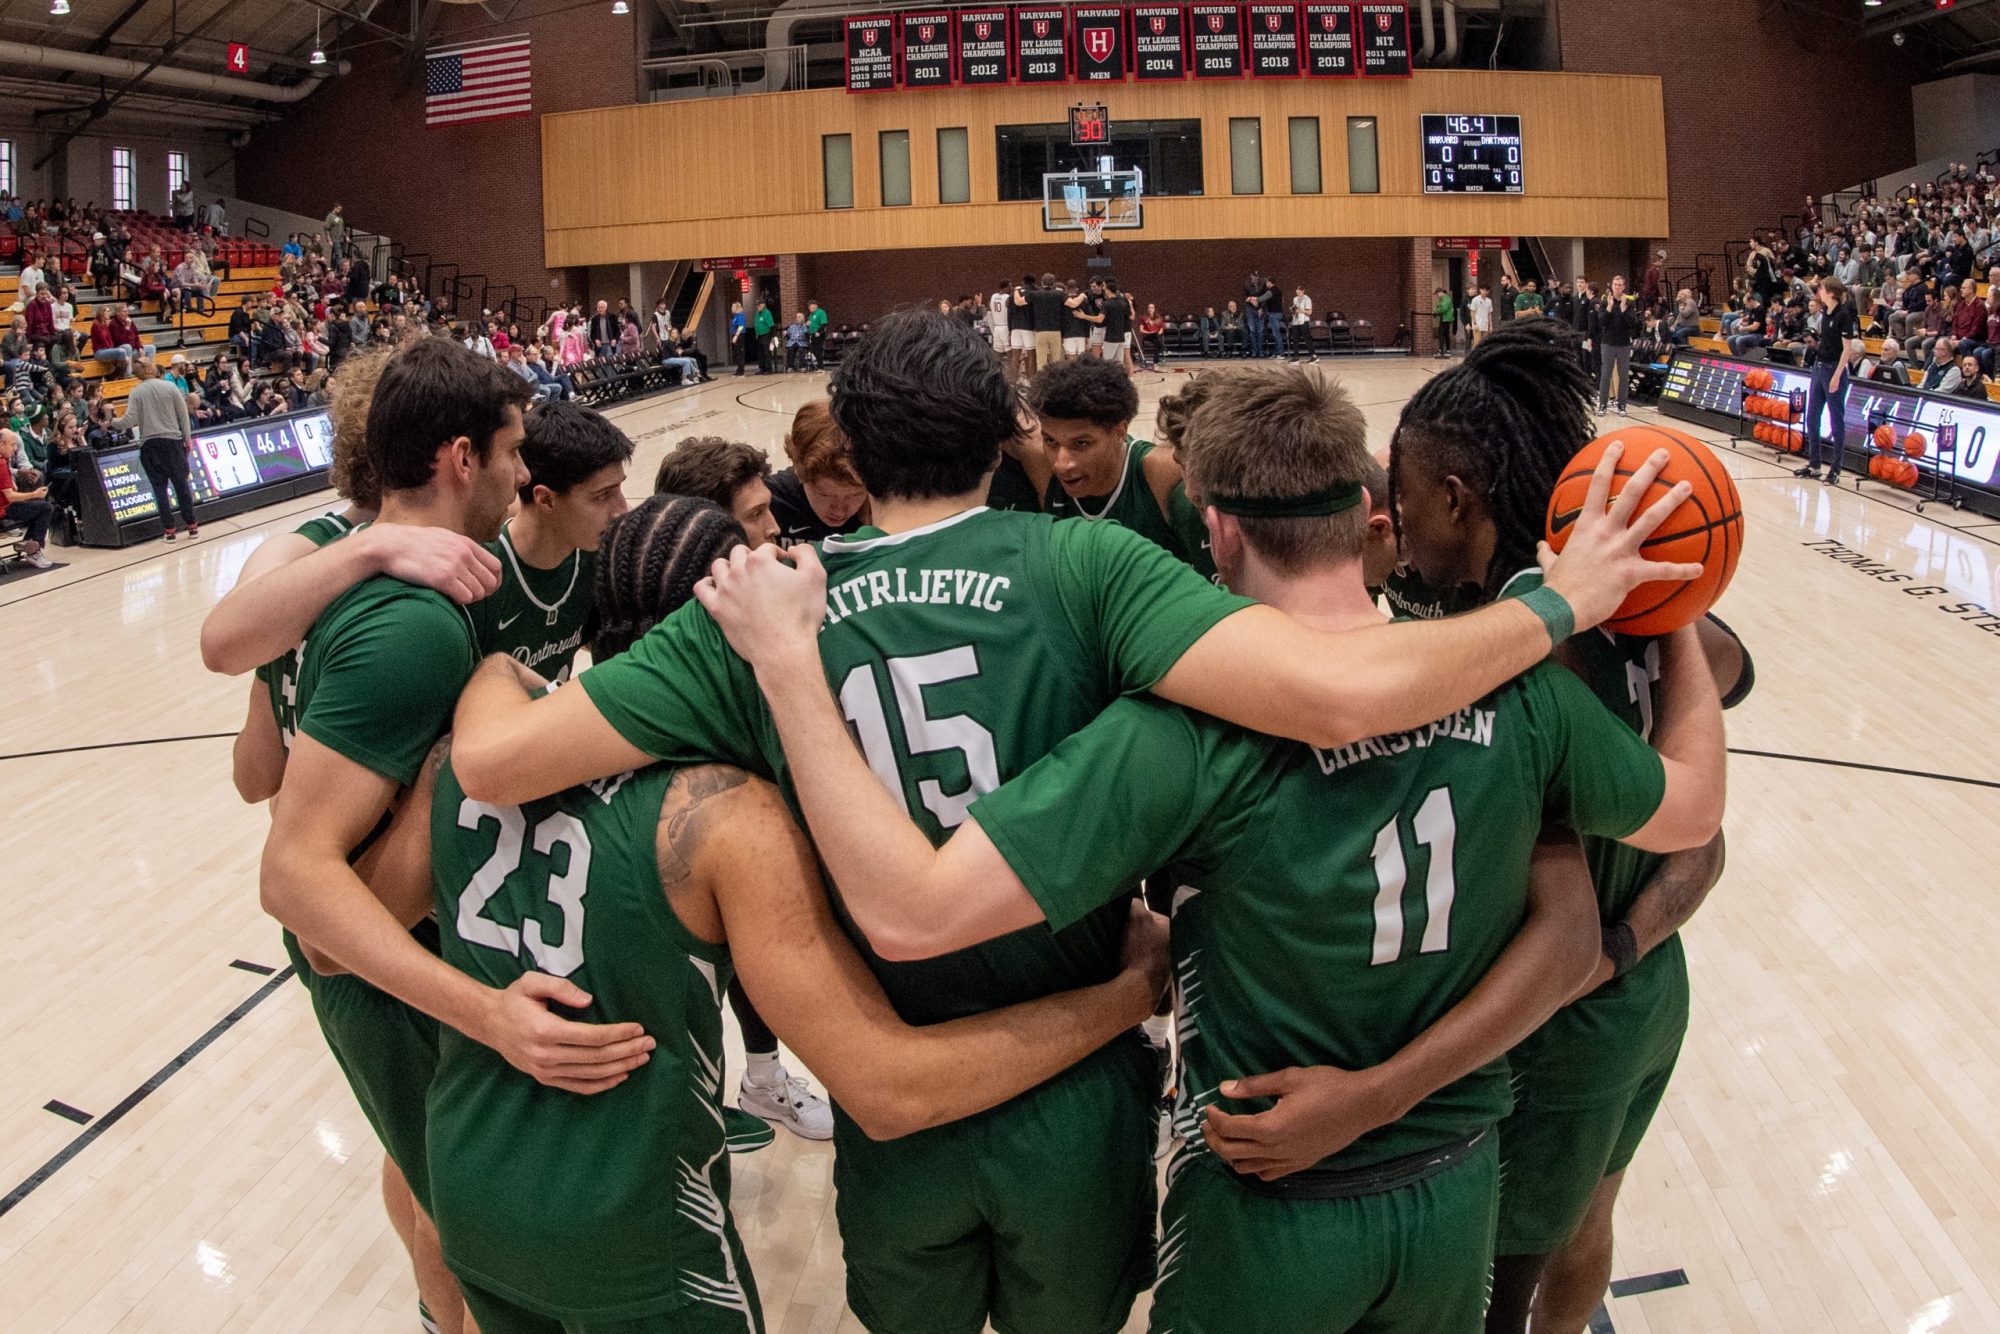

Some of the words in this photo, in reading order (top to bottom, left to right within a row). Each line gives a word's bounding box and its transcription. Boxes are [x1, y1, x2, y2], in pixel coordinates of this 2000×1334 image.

[1077, 9, 1120, 18] HARVARD
[1136, 8, 1179, 16] HARVARD
[1194, 6, 1236, 14] HARVARD
[1252, 5, 1294, 13] HARVARD
[1308, 5, 1349, 13] HARVARD
[1363, 5, 1404, 13] HARVARD
[906, 15, 947, 25] HARVARD
[962, 12, 1004, 22] HARVARD
[1019, 10, 1062, 20] HARVARD
[849, 20, 890, 29] HARVARD
[1154, 20, 1162, 29] H
[1211, 17, 1220, 27] H
[1269, 17, 1278, 27] H
[1325, 17, 1333, 26] H
[1379, 17, 1388, 26] H
[923, 27, 930, 38] H
[979, 25, 987, 35] H
[1037, 23, 1045, 33] H
[866, 31, 874, 41] H
[1152, 36, 1179, 44] LEAGUE
[1210, 34, 1237, 42] LEAGUE
[1268, 34, 1295, 42] LEAGUE
[1310, 34, 1322, 42] IVY
[1324, 34, 1351, 42] LEAGUE
[963, 42, 975, 50] IVY
[1020, 40, 1033, 48] IVY
[1036, 39, 1062, 47] LEAGUE
[1091, 32, 1107, 52] H
[1196, 42, 1238, 50] CHAMPIONS
[1254, 41, 1296, 49] CHAMPIONS
[1309, 41, 1352, 49] CHAMPIONS
[1376, 37, 1394, 46] NIT
[859, 48, 882, 57] NCAA
[907, 45, 919, 53] IVY
[921, 44, 947, 53] LEAGUE
[1020, 47, 1064, 56] CHAMPIONS
[1138, 43, 1180, 52] CHAMPIONS
[234, 48, 244, 68] 4
[907, 51, 948, 61] CHAMPIONS
[963, 48, 1005, 58] CHAMPIONS
[850, 56, 891, 64] TOURNAMENT
[1146, 59, 1173, 70] 2014
[1204, 58, 1232, 69] 2015
[1262, 57, 1289, 68] 2018
[1318, 57, 1345, 67] 2019
[915, 68, 940, 78] 2011
[971, 65, 998, 76] 2012
[1029, 63, 1056, 74] 2013
[1090, 72, 1110, 80] MEN
[1450, 117, 1484, 133] 46.4
[1079, 121, 1102, 140] 30
[1429, 136, 1458, 144] HARVARD
[1481, 136, 1519, 145] DARTMOUTH
[1442, 146, 1452, 162] 0
[1508, 147, 1518, 163] 0
[1433, 170, 1440, 183] 0
[1447, 174, 1454, 182] 4
[1495, 174, 1501, 182] 4
[1511, 171, 1518, 183] 0
[304, 424, 313, 440] 0
[256, 429, 290, 454] 46.4
[228, 439, 237, 456] 0
[1965, 426, 1986, 468] 0
[110, 464, 130, 475] MACK
[113, 473, 141, 486] OKPARA
[120, 492, 154, 507] AJOGBOR
[1801, 539, 1914, 582] THOMAS
[1902, 586, 1948, 599] G.
[1938, 602, 2000, 637] STE
[819, 568, 1010, 632] ITRIJEVIC
[840, 645, 1000, 828] 15
[1370, 786, 1456, 966] 11
[457, 797, 592, 978] 23
